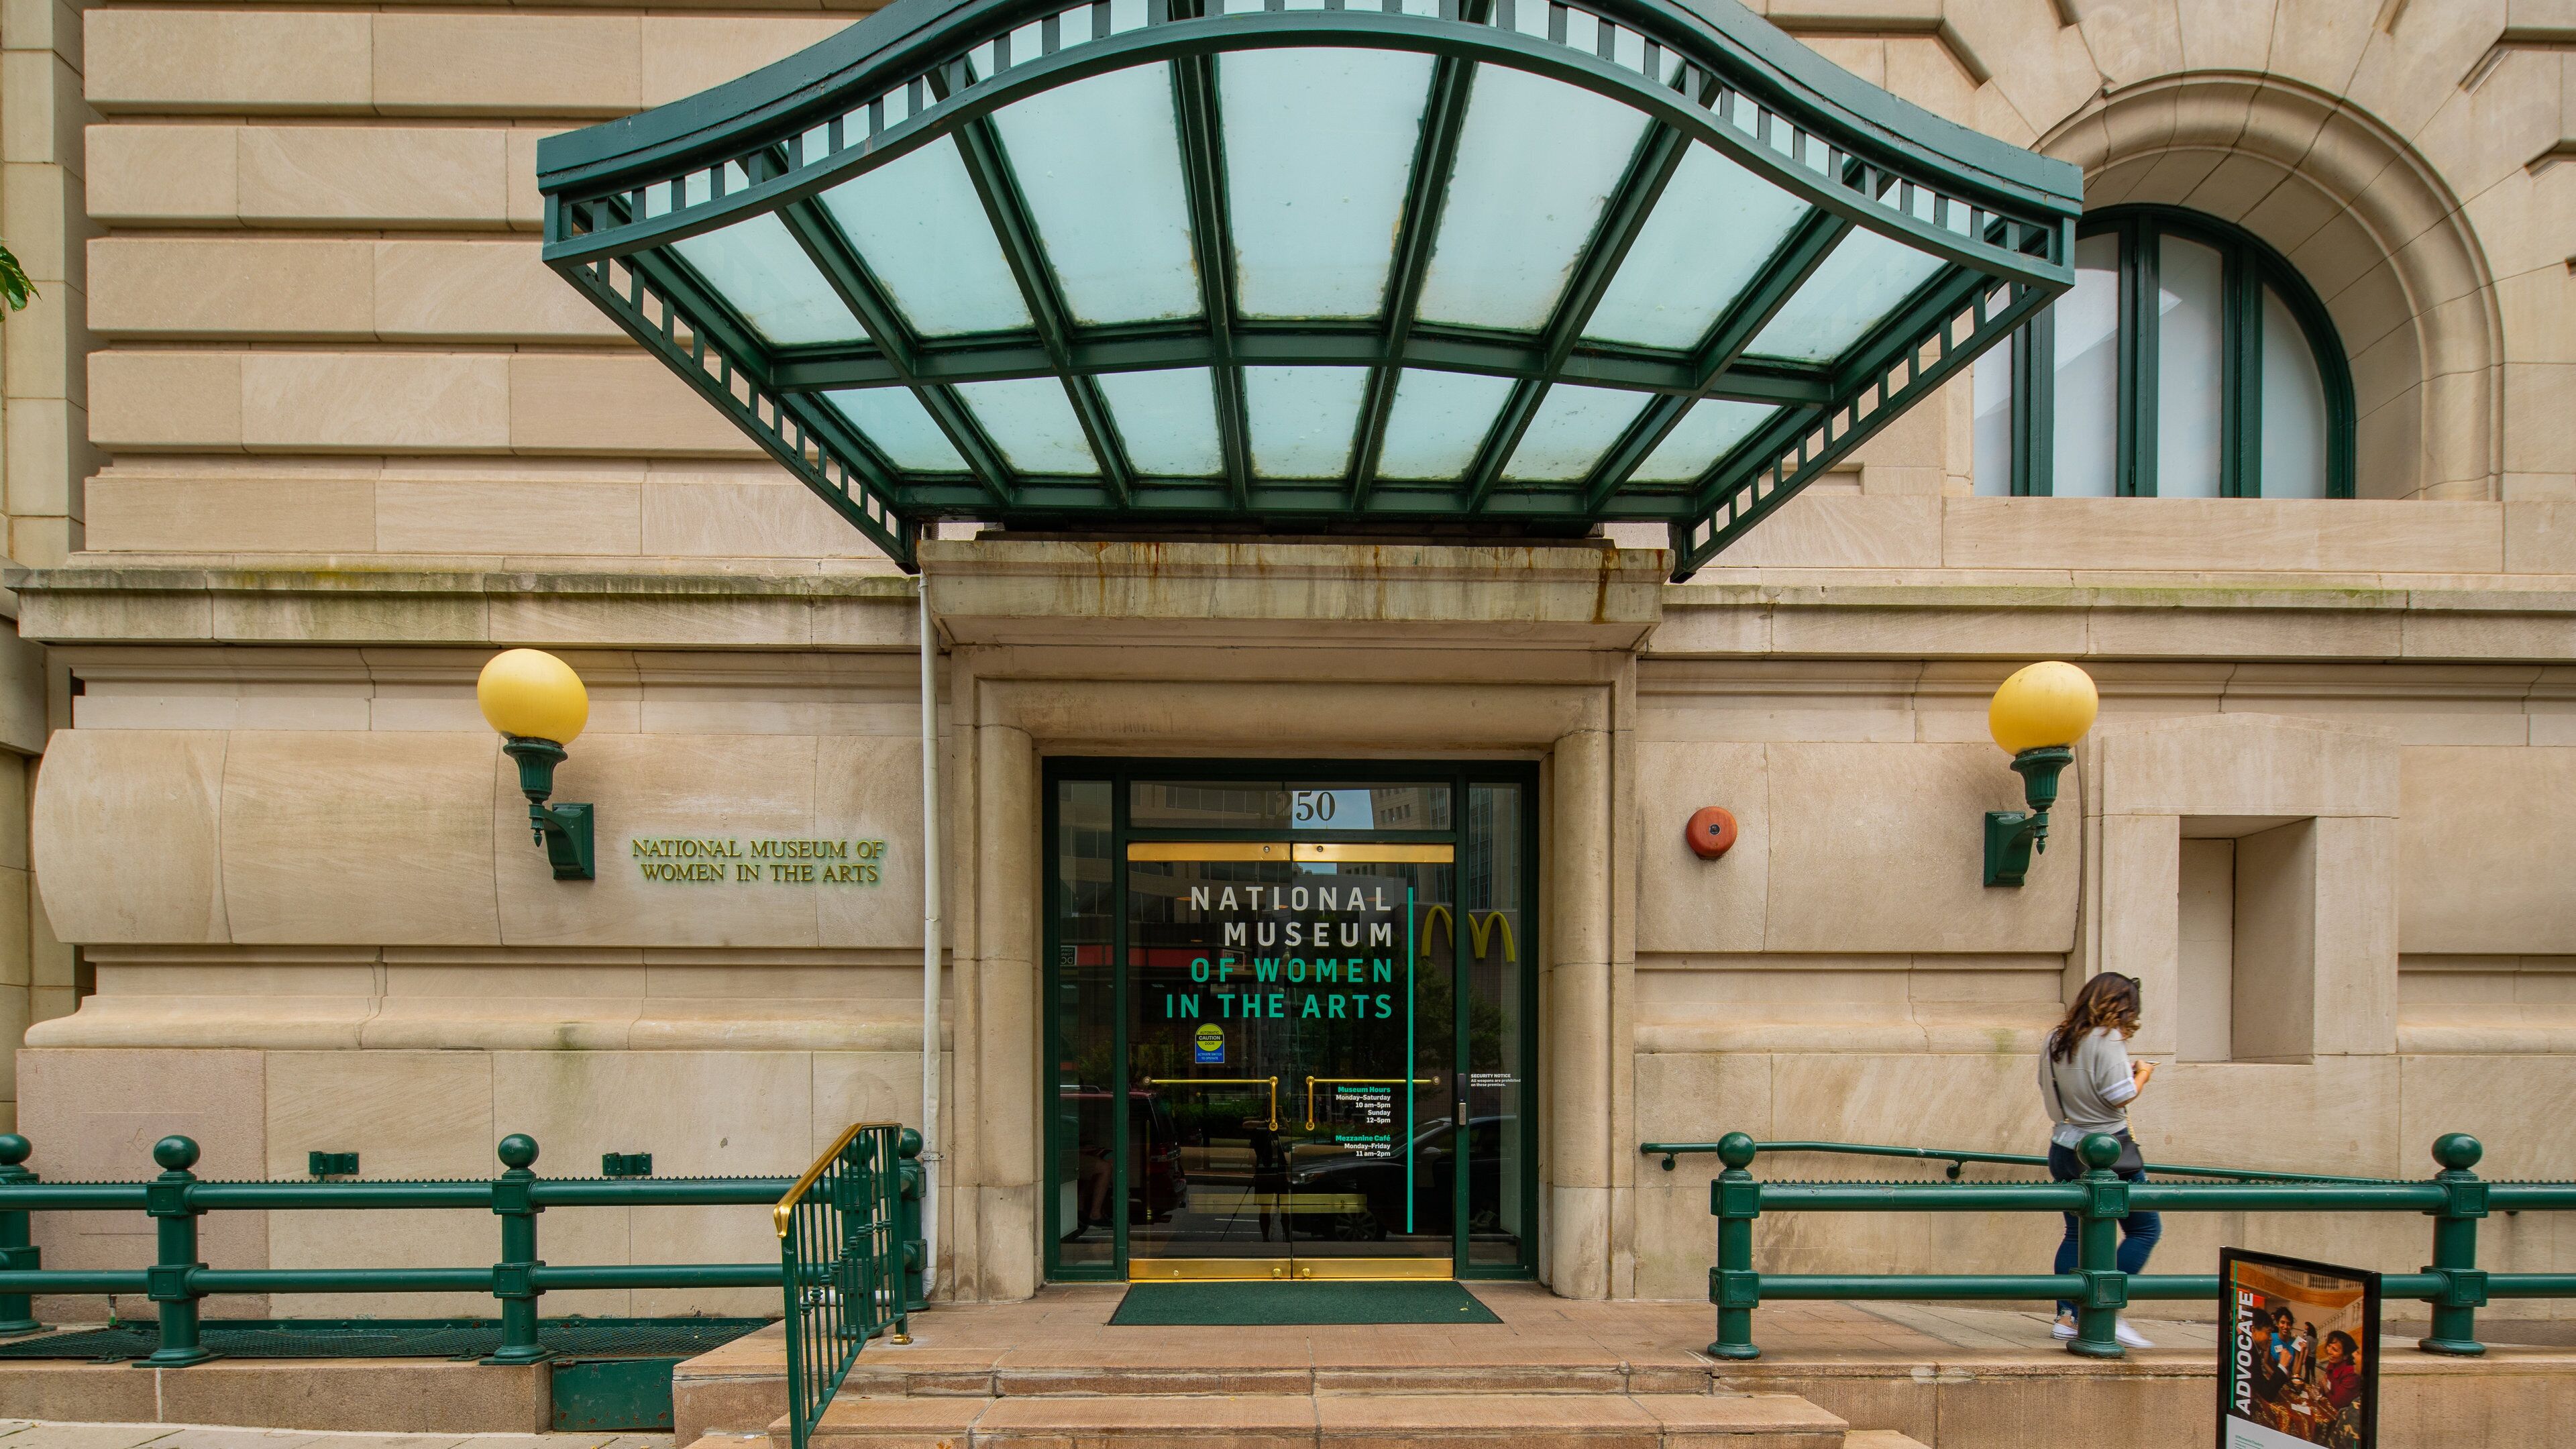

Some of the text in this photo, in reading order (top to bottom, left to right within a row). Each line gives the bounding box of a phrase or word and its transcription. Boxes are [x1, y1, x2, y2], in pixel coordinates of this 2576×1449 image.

[633, 839, 885, 859] NATIONAL MUSEUM OF
[641, 863, 879, 882] WOMEN IN THE ARTS
[1191, 886, 1391, 911] NATIONAL
[1224, 922, 1391, 947] MUSEUM
[1191, 958, 1235, 983] OF
[1254, 958, 1391, 983] WOMEN
[1167, 994, 1392, 1018] IN THE ARTS
[2236, 1291, 2253, 1415] ADVOCATE
